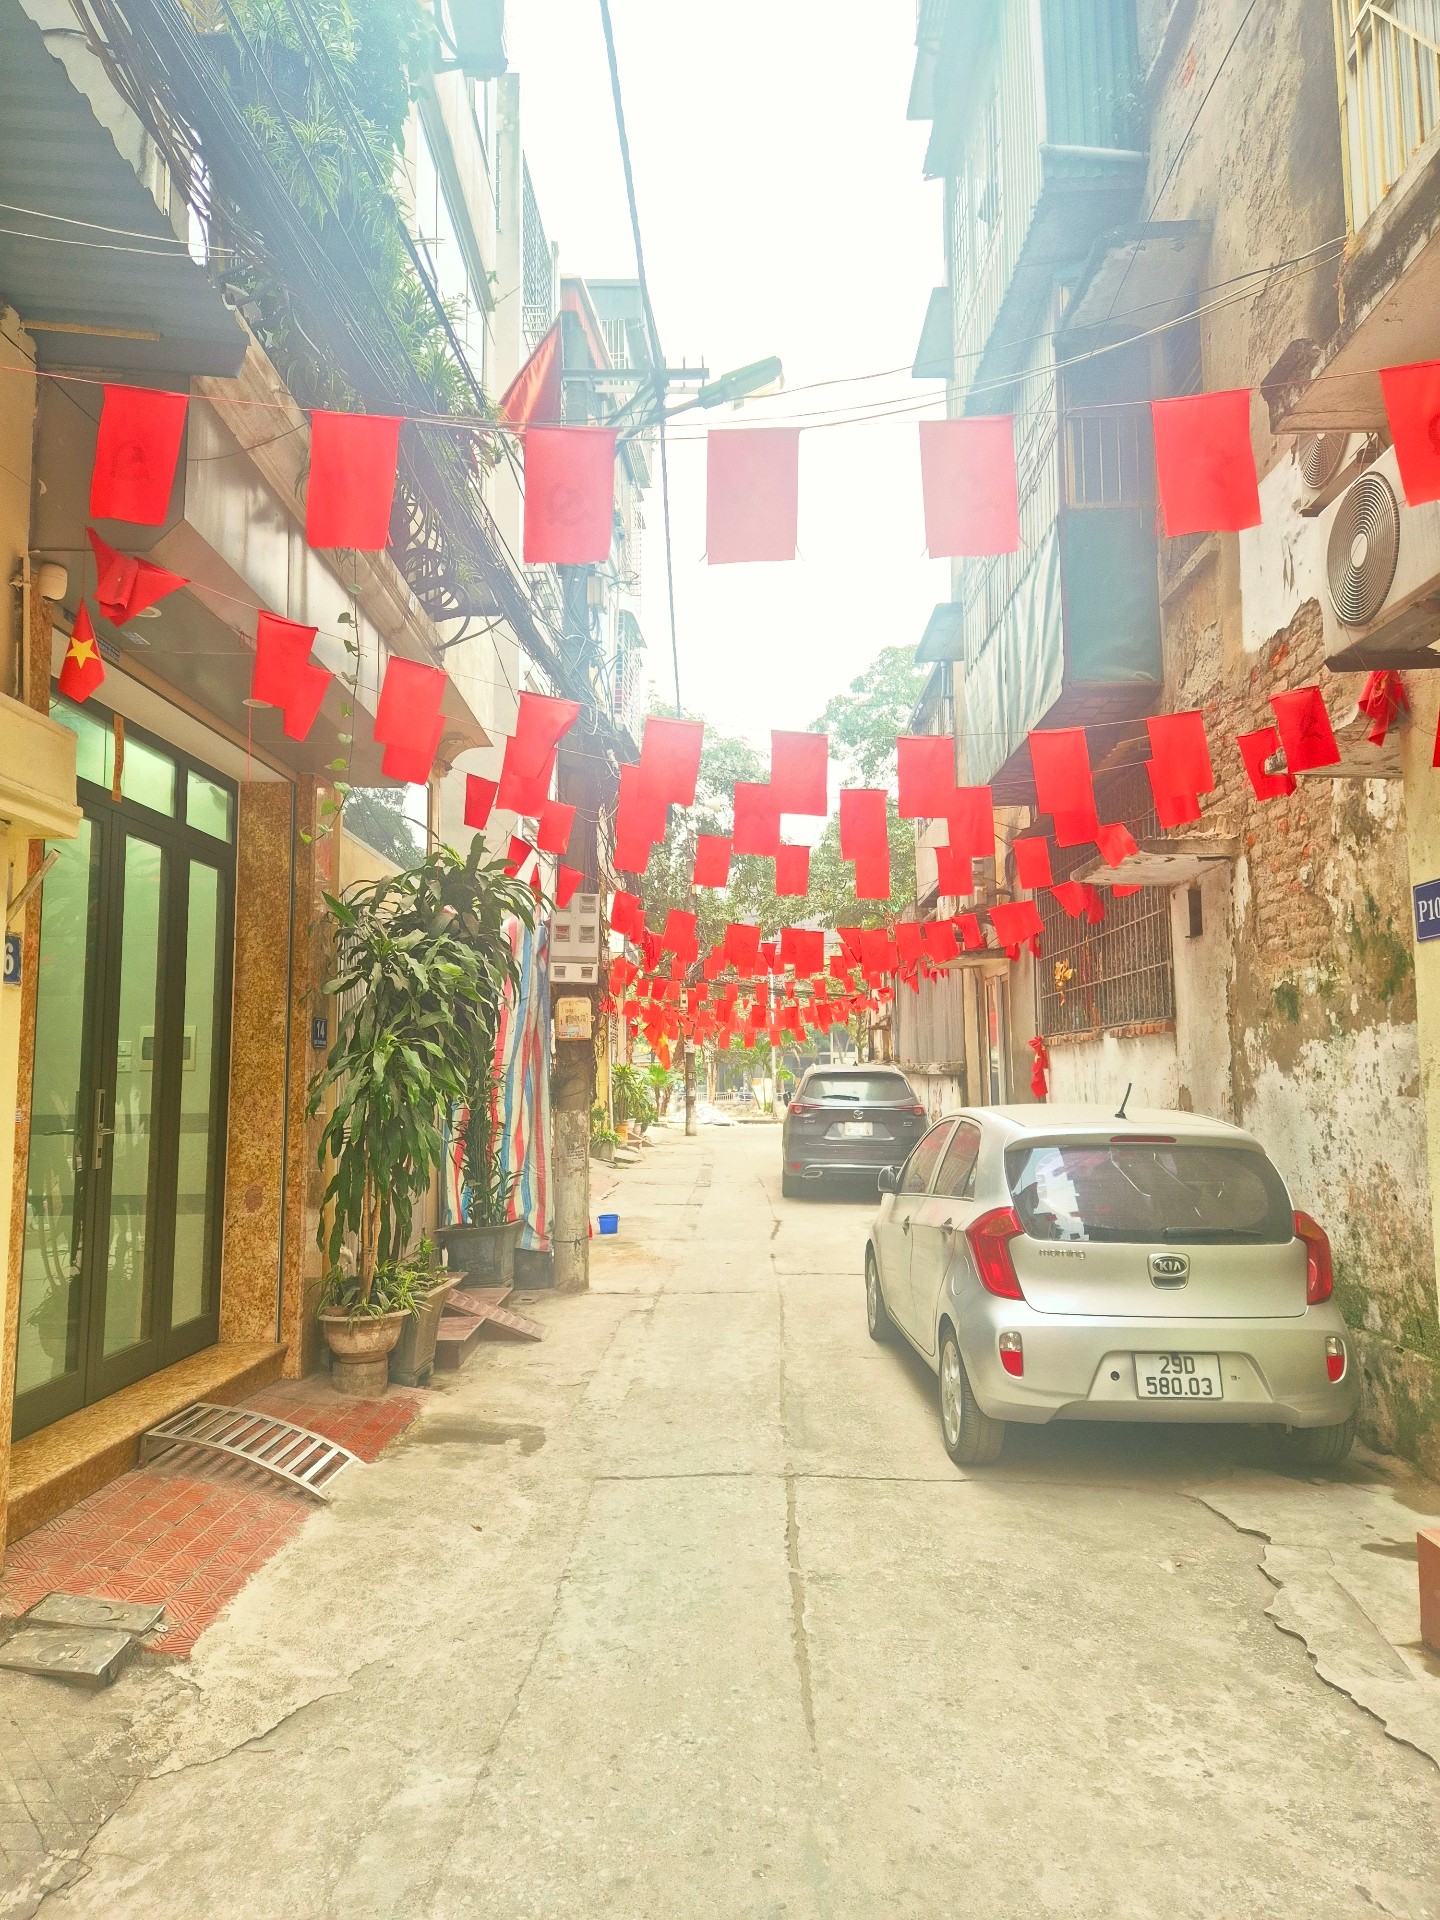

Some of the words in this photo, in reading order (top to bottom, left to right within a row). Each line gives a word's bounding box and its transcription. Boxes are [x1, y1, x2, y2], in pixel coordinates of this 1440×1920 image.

[316, 1020, 325, 1039] 14
[1039, 1248, 1086, 1260] morning
[1158, 1260, 1182, 1272] KIA
[1158, 1355, 1196, 1375] 29D
[1145, 1376, 1213, 1396] 580.03
